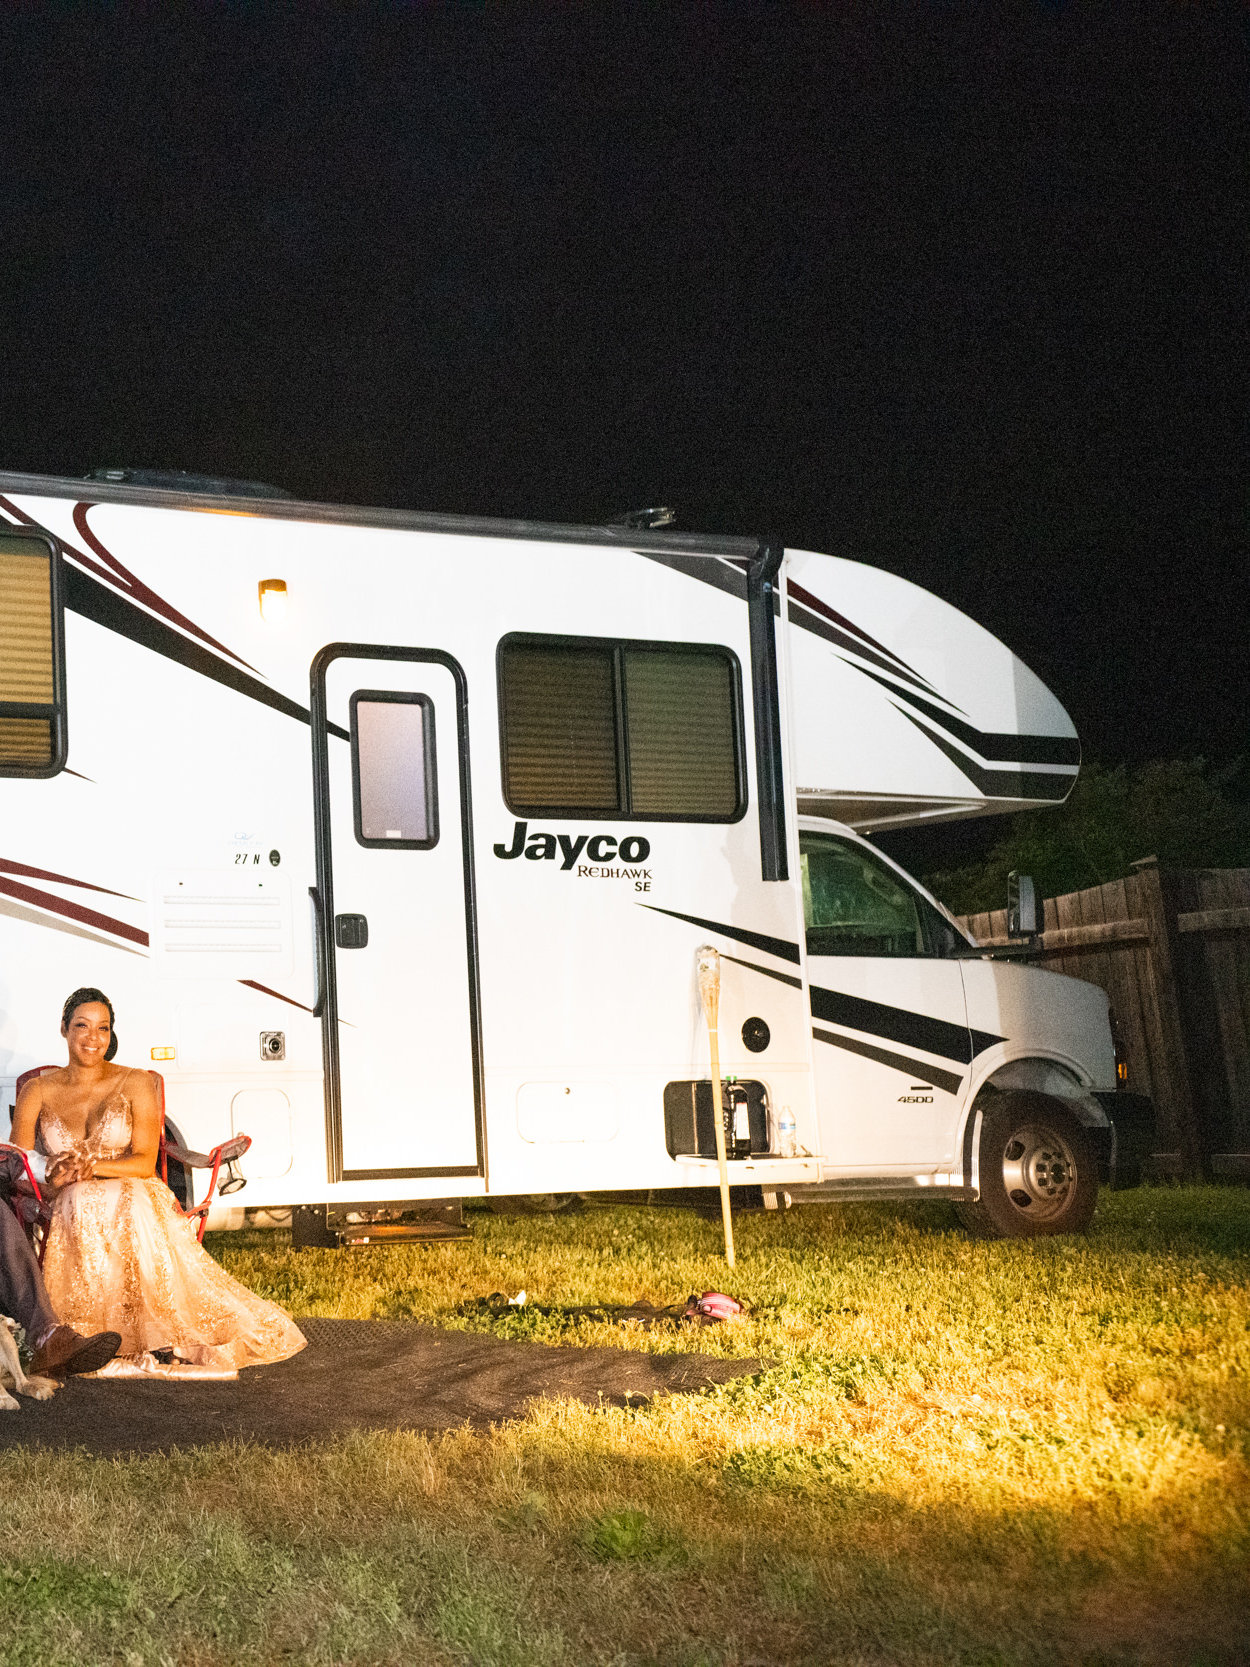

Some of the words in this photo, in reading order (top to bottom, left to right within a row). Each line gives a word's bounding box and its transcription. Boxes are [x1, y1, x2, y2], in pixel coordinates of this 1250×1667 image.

[493, 821, 651, 871] Jayco
[234, 853, 249, 865] 27
[253, 853, 261, 865] N
[576, 865, 653, 880] REDHAWK
[634, 881, 652, 892] SE
[897, 1095, 934, 1104] 4500
